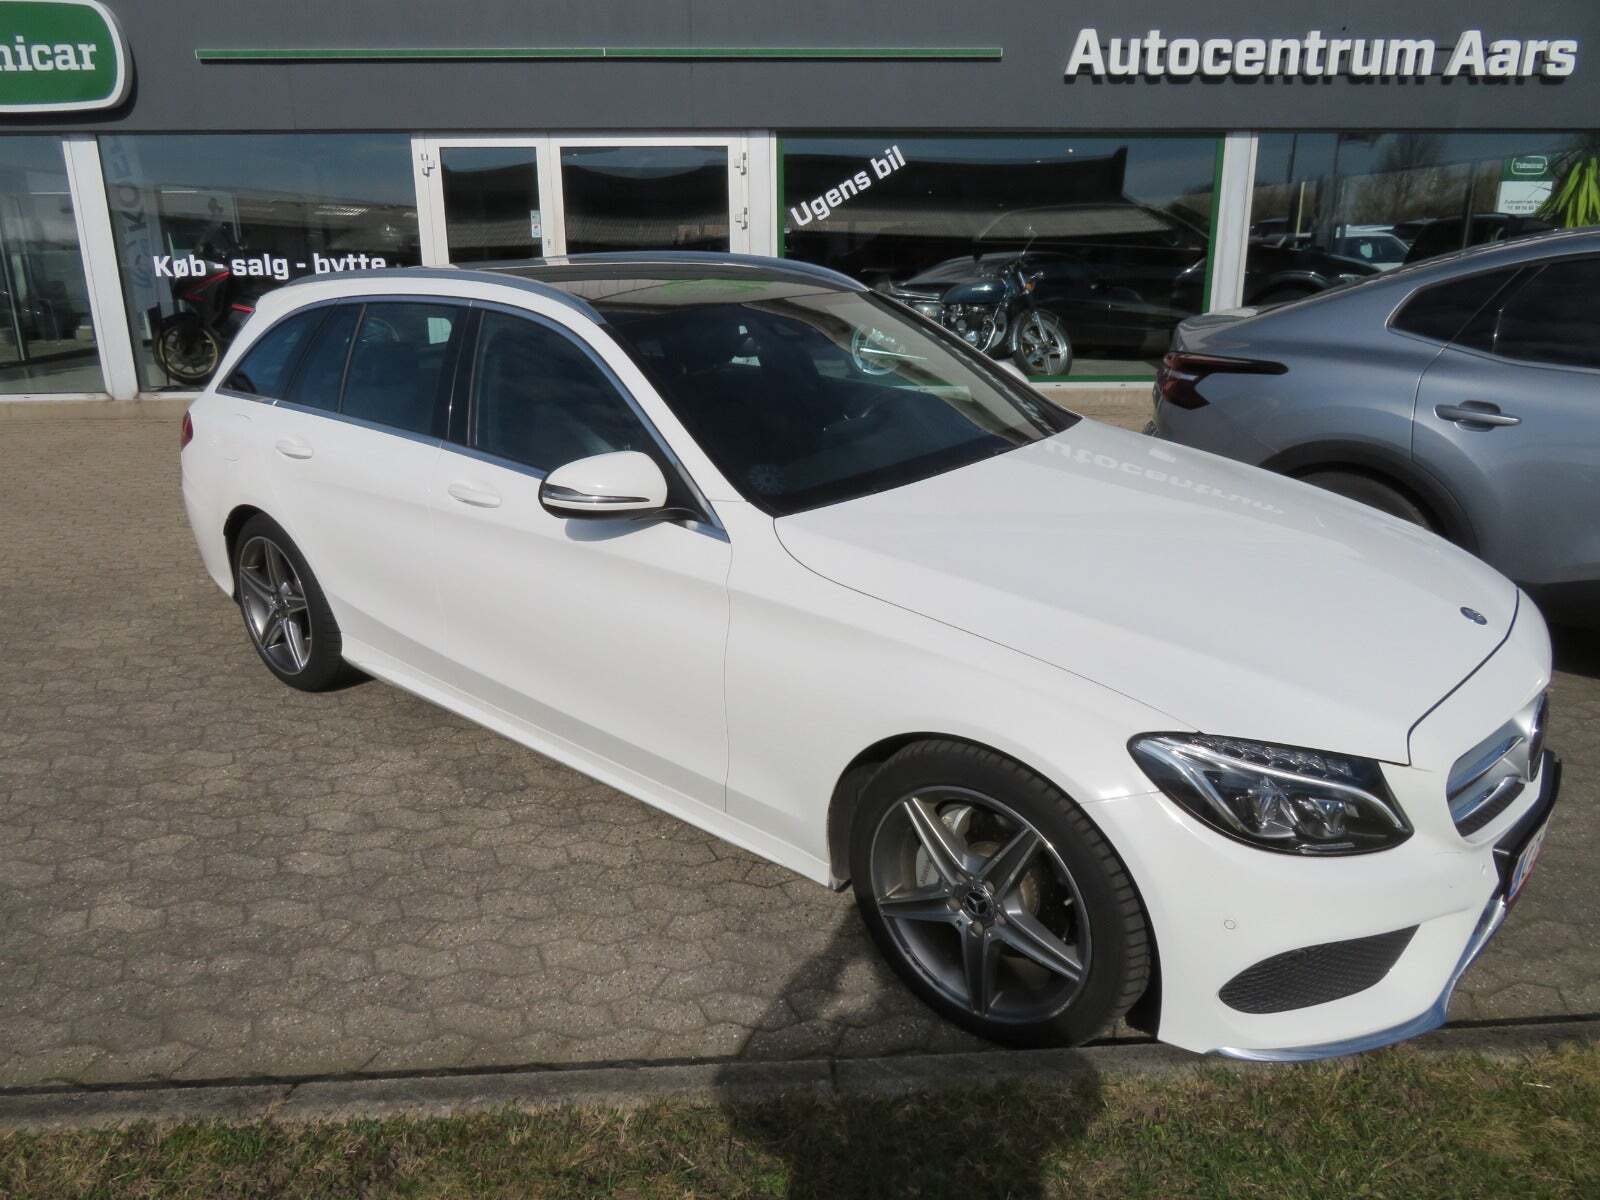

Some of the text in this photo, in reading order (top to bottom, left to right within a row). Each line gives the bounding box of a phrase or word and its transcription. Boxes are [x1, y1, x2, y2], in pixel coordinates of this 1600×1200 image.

[1064, 28, 1578, 77] Autocentrum Aars
[790, 144, 906, 226] Ugens bil
[153, 254, 207, 278] Køb
[231, 253, 290, 280] salg
